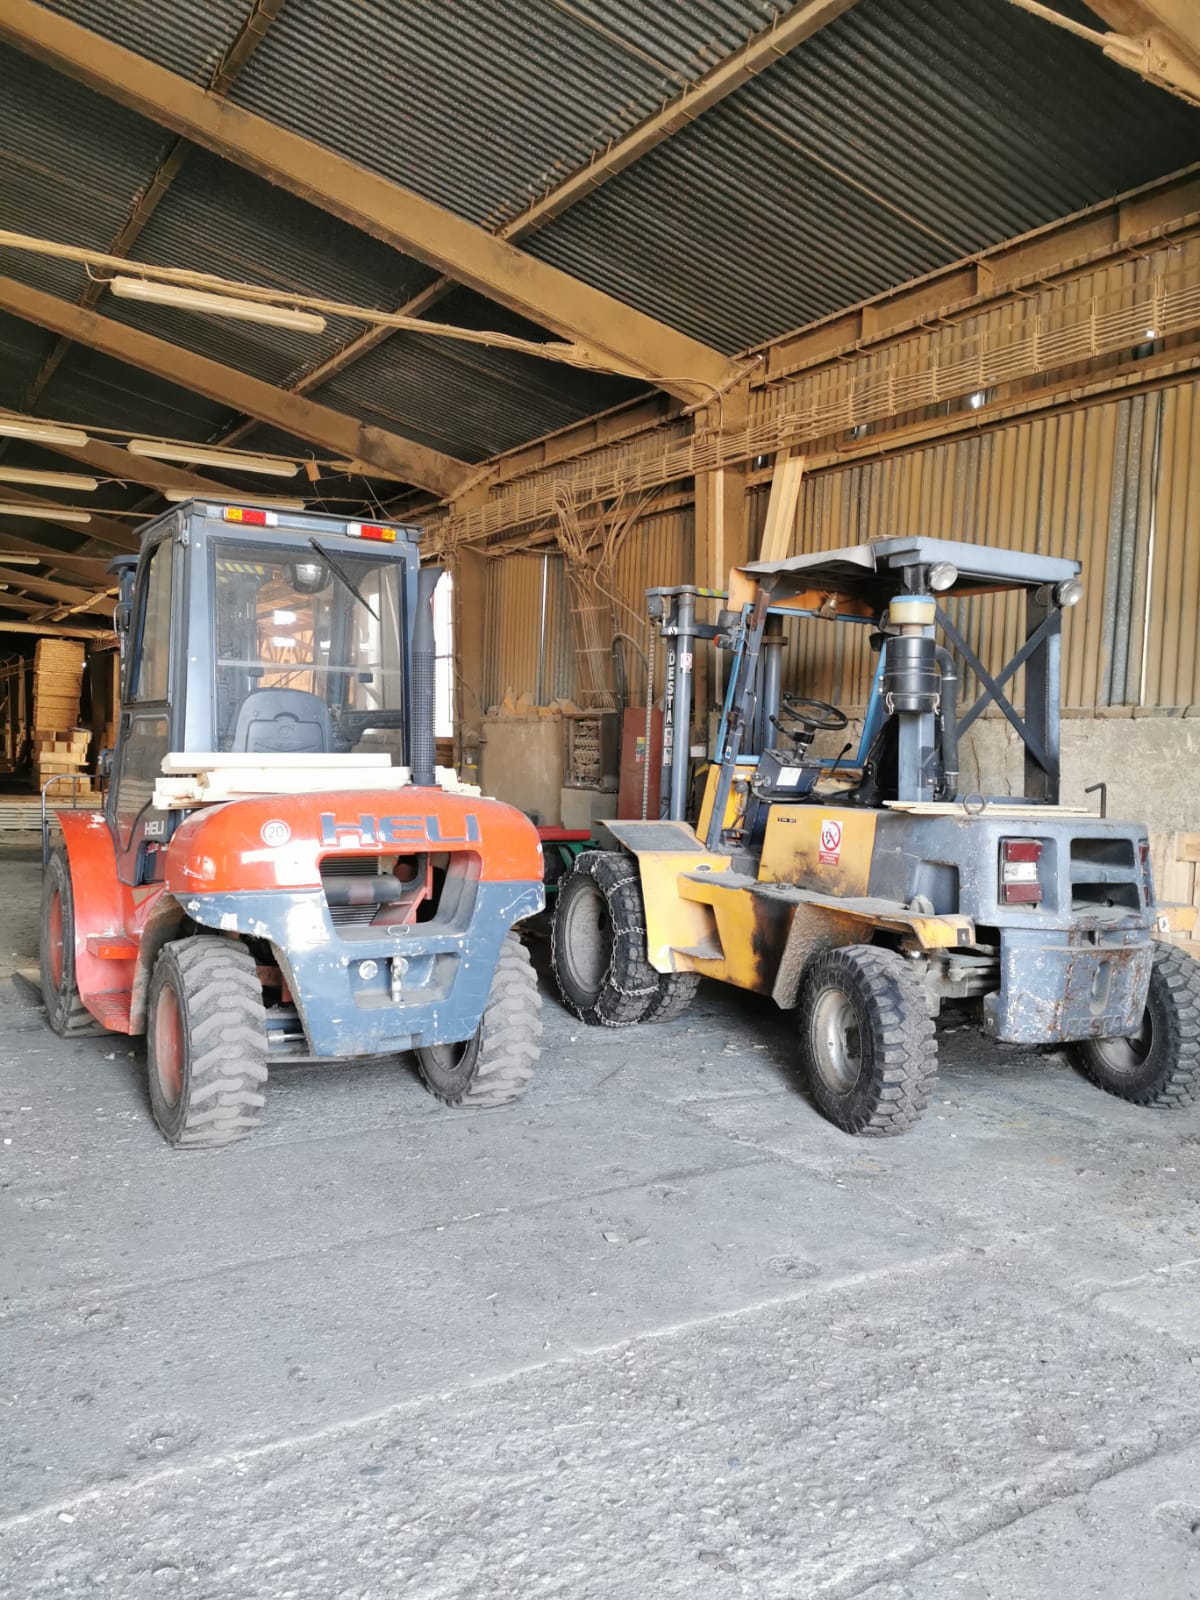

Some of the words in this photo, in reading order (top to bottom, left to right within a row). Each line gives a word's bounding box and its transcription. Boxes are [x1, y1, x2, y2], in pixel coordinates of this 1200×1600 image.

[666, 650, 676, 725] DESTA
[144, 820, 165, 836] HELI
[268, 825, 284, 838] 20
[319, 812, 481, 847] HELI
